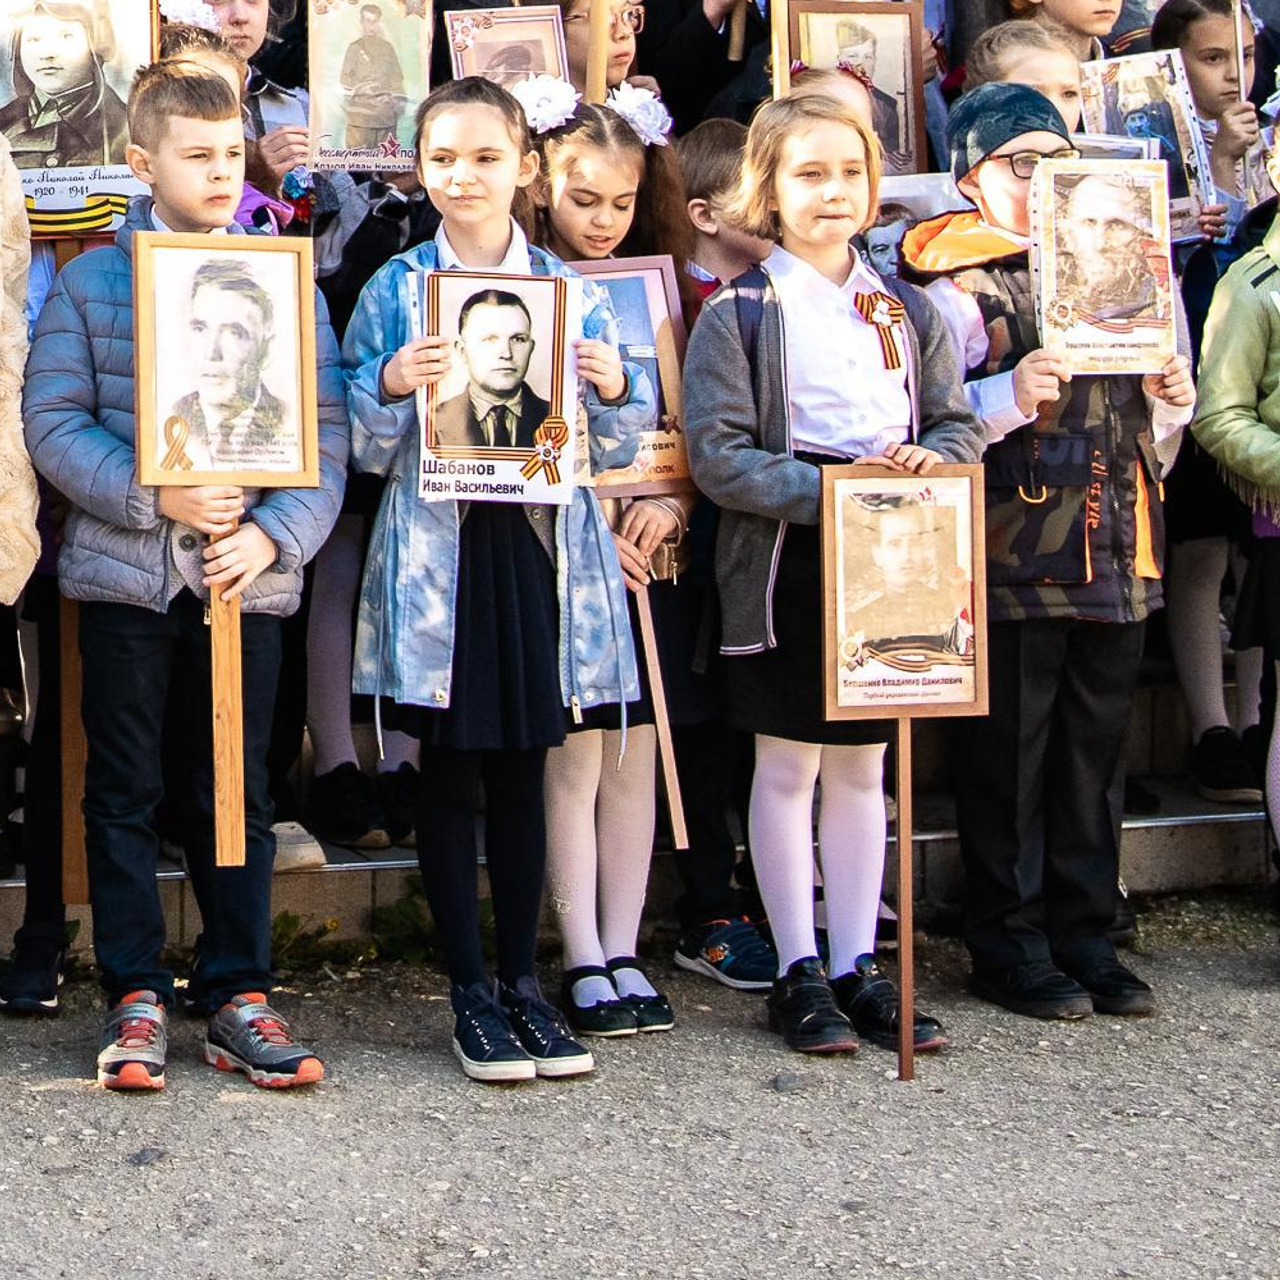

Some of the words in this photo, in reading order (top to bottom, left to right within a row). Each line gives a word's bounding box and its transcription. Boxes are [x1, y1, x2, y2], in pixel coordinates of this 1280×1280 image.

[400, 148, 416, 159] ПО
[348, 161, 372, 170] Иван
[36, 170, 85, 184] Николай
[34, 186, 56, 200] 1920
[68, 185, 90, 200] 1941
[640, 441, 676, 451] исович
[422, 459, 496, 476] Шабанов
[423, 479, 451, 493] Иван
[454, 480, 524, 496] Васильевич
[882, 678, 920, 687] Владимир
[922, 677, 963, 686] Данилович
